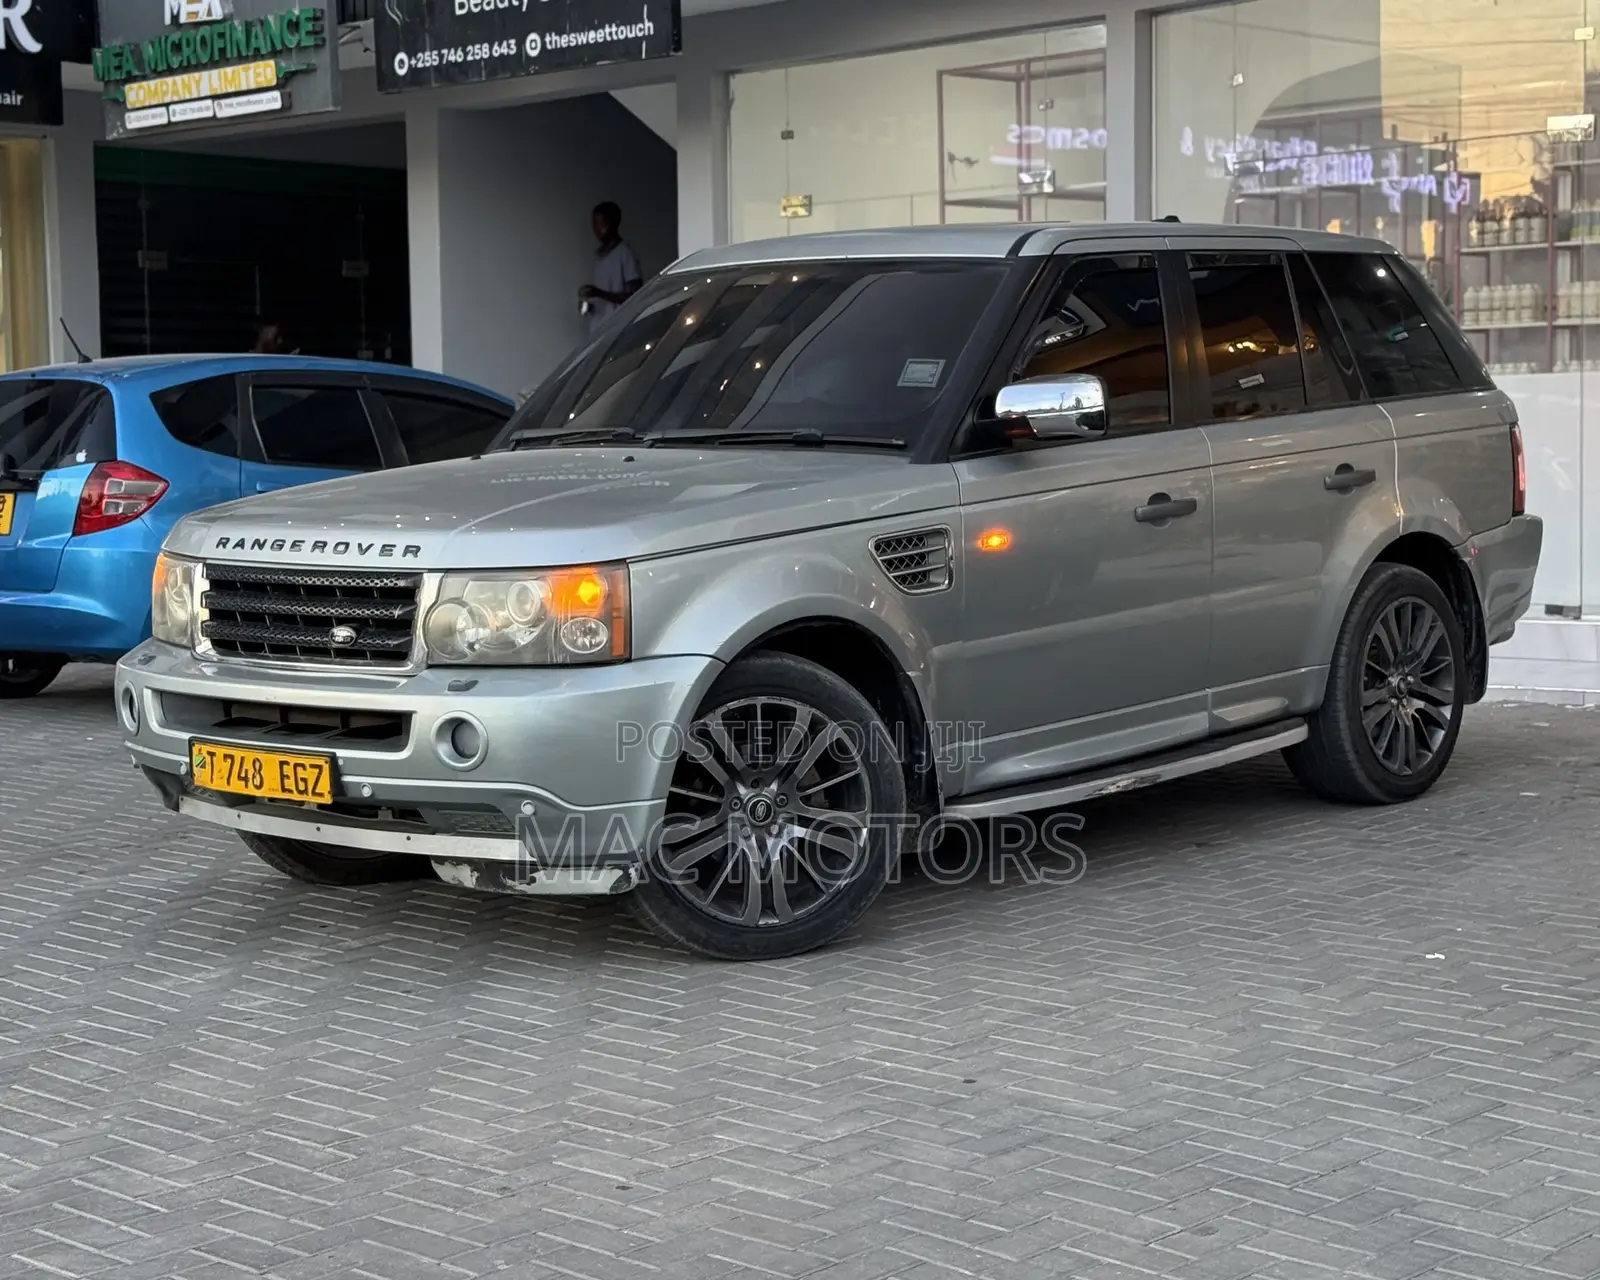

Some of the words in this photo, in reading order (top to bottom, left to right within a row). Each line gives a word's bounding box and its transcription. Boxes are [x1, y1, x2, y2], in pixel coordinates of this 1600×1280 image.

[92, 45, 137, 82] MEA
[142, 8, 316, 73] MICROFINANCE
[410, 51, 440, 68] +255
[441, 46, 464, 64] 746
[466, 43, 490, 60] 258
[492, 39, 516, 58] 643
[545, 20, 654, 50] thesweettouch
[0, 90, 24, 106] air
[126, 74, 202, 107] COMPANY
[208, 63, 276, 94] LIMITED
[206, 750, 217, 784] T
[223, 753, 265, 791] 748
[278, 760, 326, 798] EGZ
